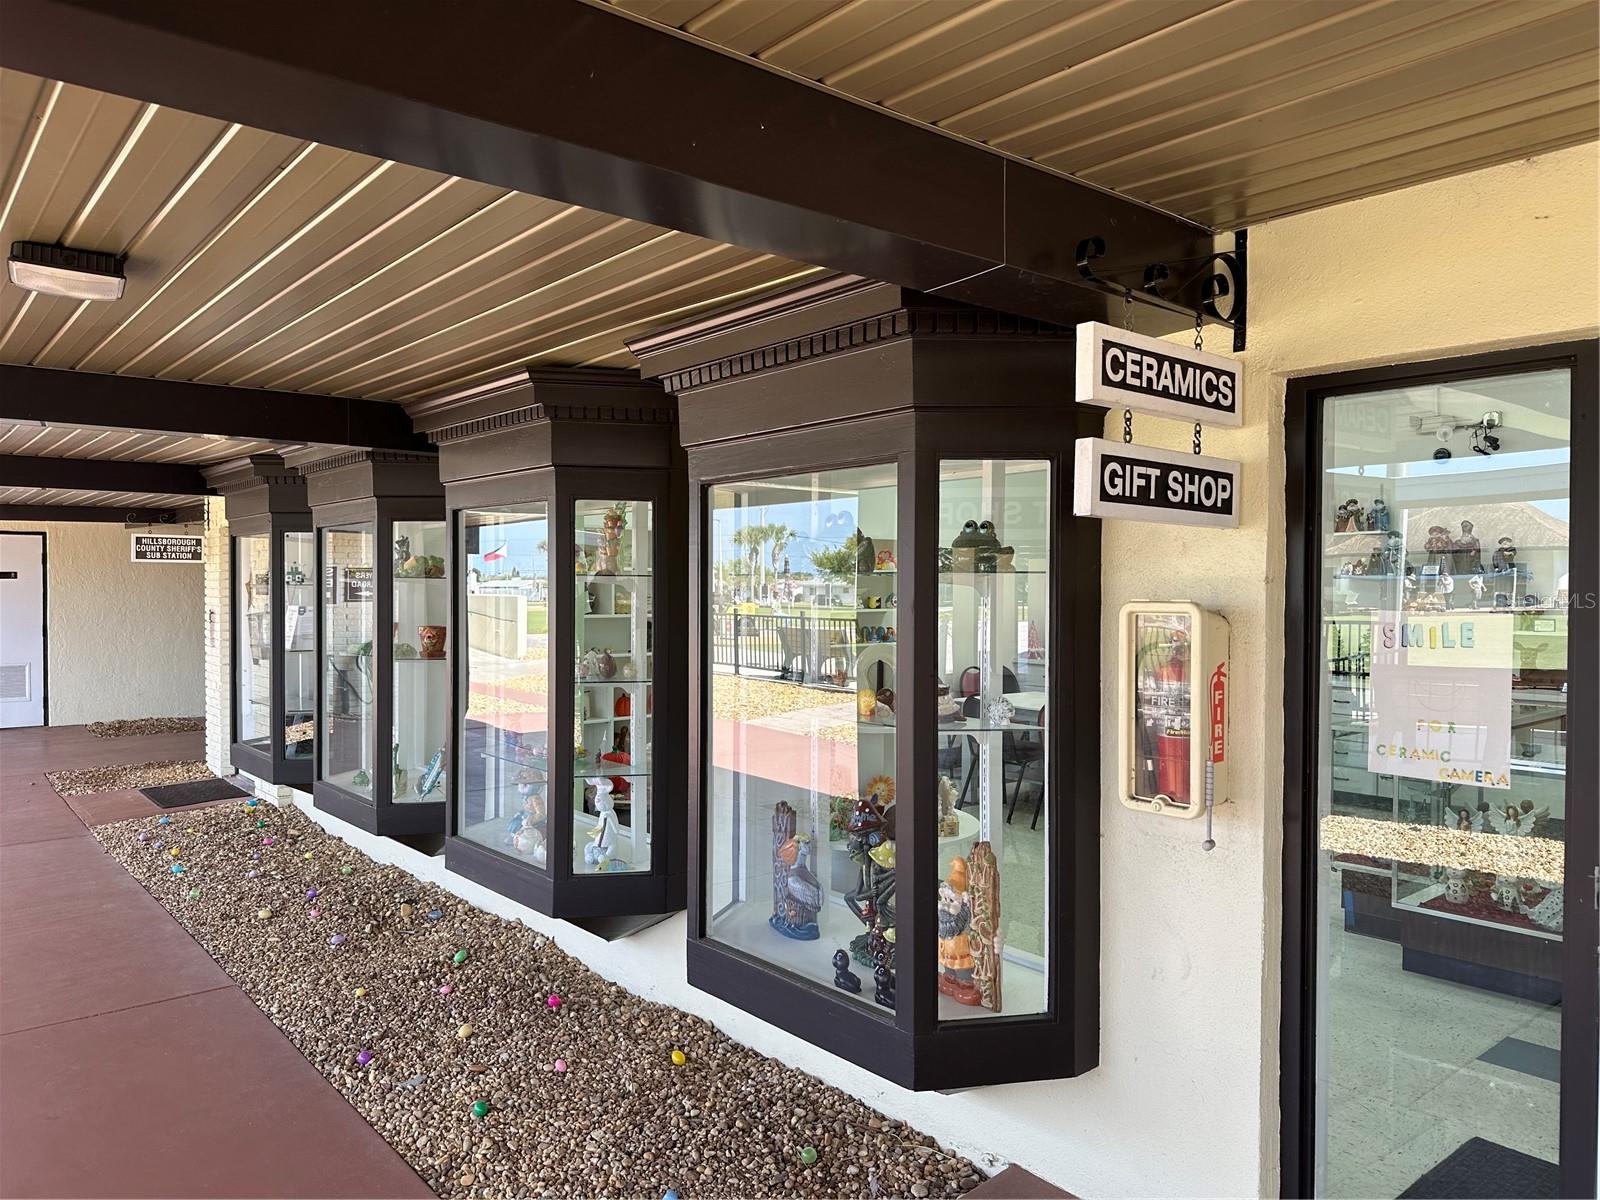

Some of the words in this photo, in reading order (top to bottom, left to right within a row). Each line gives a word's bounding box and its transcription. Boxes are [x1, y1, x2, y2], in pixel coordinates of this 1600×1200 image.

[1105, 347, 1233, 407] CERAMICS
[1103, 461, 1161, 500] GIFT
[1167, 470, 1231, 508] SHOP
[136, 544, 165, 552] COUNTY
[166, 545, 202, 553] SHERIFF'S
[141, 537, 196, 546] HILLSBOROUGH
[146, 551, 161, 559] SUB
[1383, 622, 1475, 650] SMILE
[1151, 695, 1176, 708] FIRE
[1214, 690, 1223, 755] FIRE
[1417, 719, 1457, 734] FOR
[1376, 744, 1451, 763] CERAMIC
[1439, 767, 1510, 786] CAMERA
